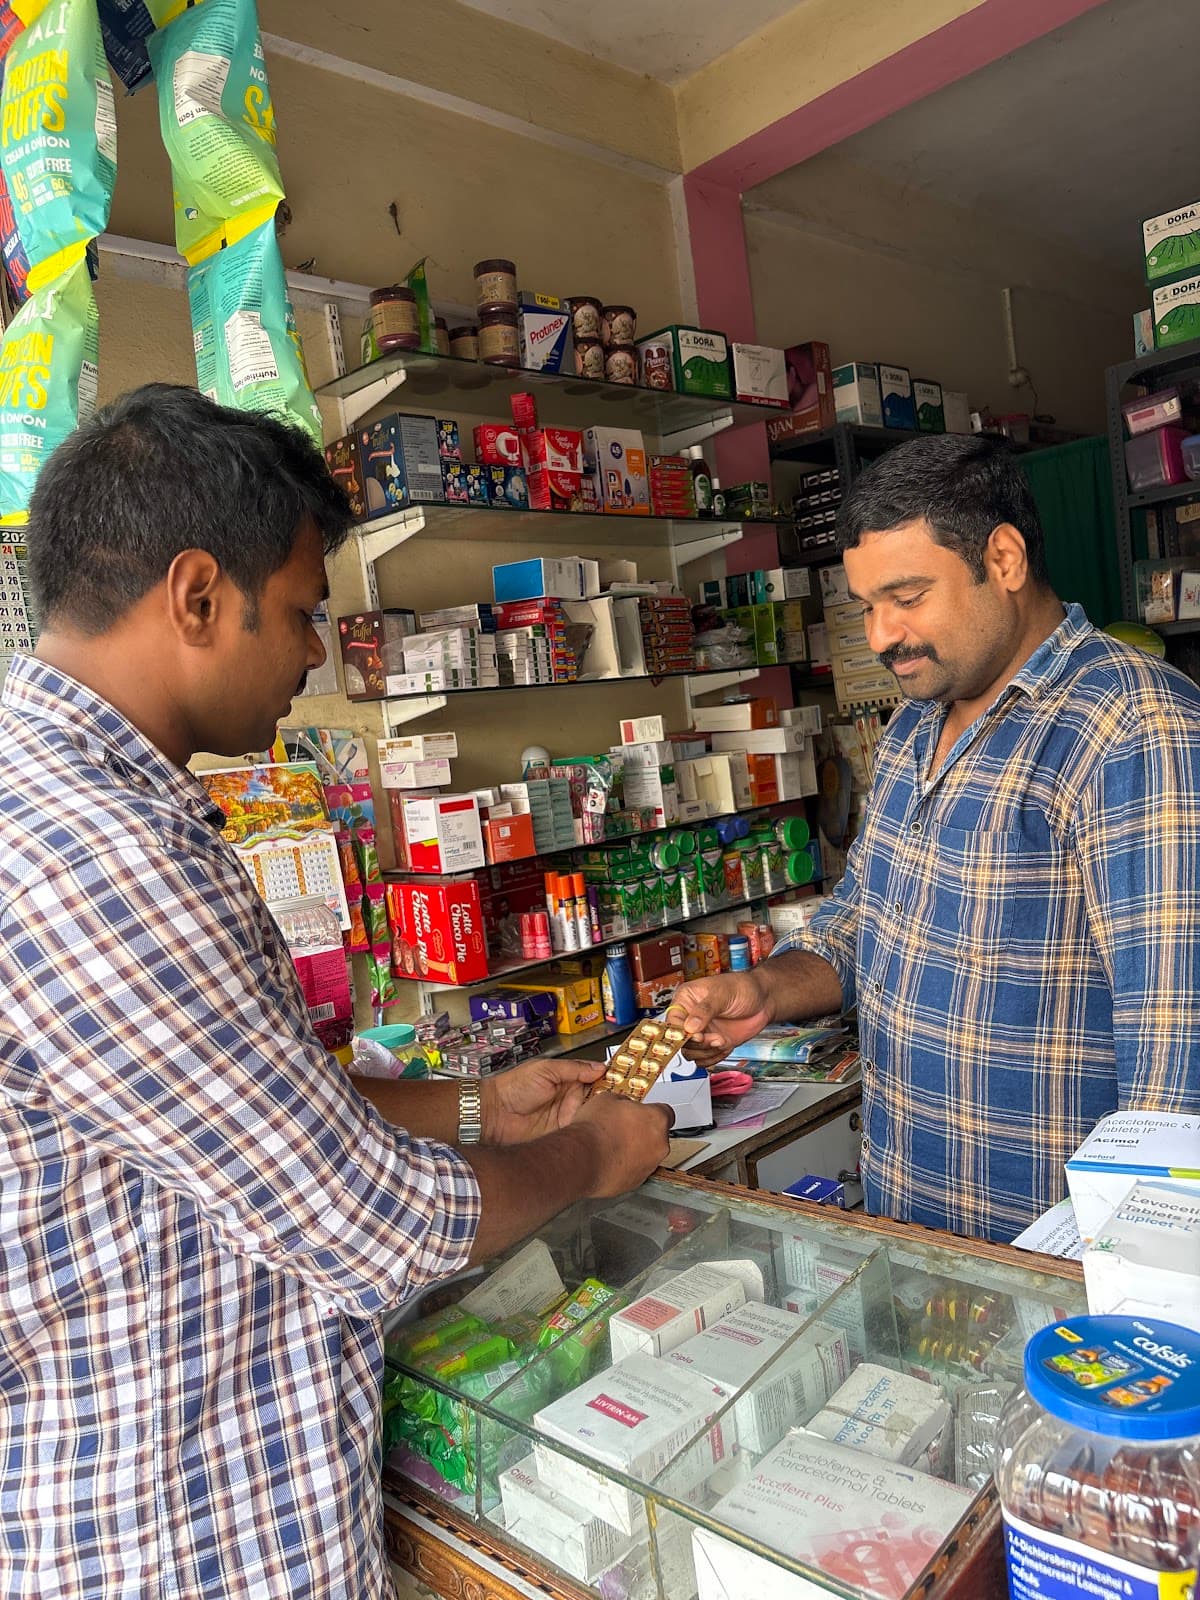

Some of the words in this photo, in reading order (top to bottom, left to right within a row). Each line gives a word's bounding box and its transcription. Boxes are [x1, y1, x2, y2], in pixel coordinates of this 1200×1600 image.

[45, 157, 73, 173] FREE
[1166, 210, 1197, 226] DORA
[693, 336, 715, 348] DORA
[2, 545, 13, 555] 24
[4, 560, 16, 570] 25
[7, 575, 19, 586] 26
[11, 591, 21, 602] 27
[13, 607, 24, 617] 28
[2, 622, 13, 633] 22
[15, 622, 27, 633] 29
[4, 637, 16, 648] 23
[17, 637, 30, 648] 30
[419, 890, 432, 934] Lotte
[461, 901, 473, 935] Lotte
[411, 889, 423, 938] Choco
[417, 938, 429, 966] Pie
[450, 903, 463, 942] Choco
[455, 942, 467, 963] Pie
[1142, 1126, 1157, 1135] IP
[1182, 1122, 1192, 1130] &
[1092, 1137, 1140, 1146] Acimol
[1082, 1153, 1116, 1161] Leeford
[1116, 1211, 1174, 1229] Lupicet
[1125, 1203, 1183, 1221] Tablets
[670, 1352, 695, 1366] Cipla
[1132, 1336, 1193, 1369] cofsils
[779, 1447, 870, 1482] Aceclofenac
[872, 1473, 886, 1487] &
[509, 1468, 534, 1487] Cipla
[770, 1455, 868, 1494] Paracetamol
[870, 1485, 927, 1514] Tablets
[752, 1473, 812, 1501] Accelent
[813, 1491, 845, 1514] Plus
